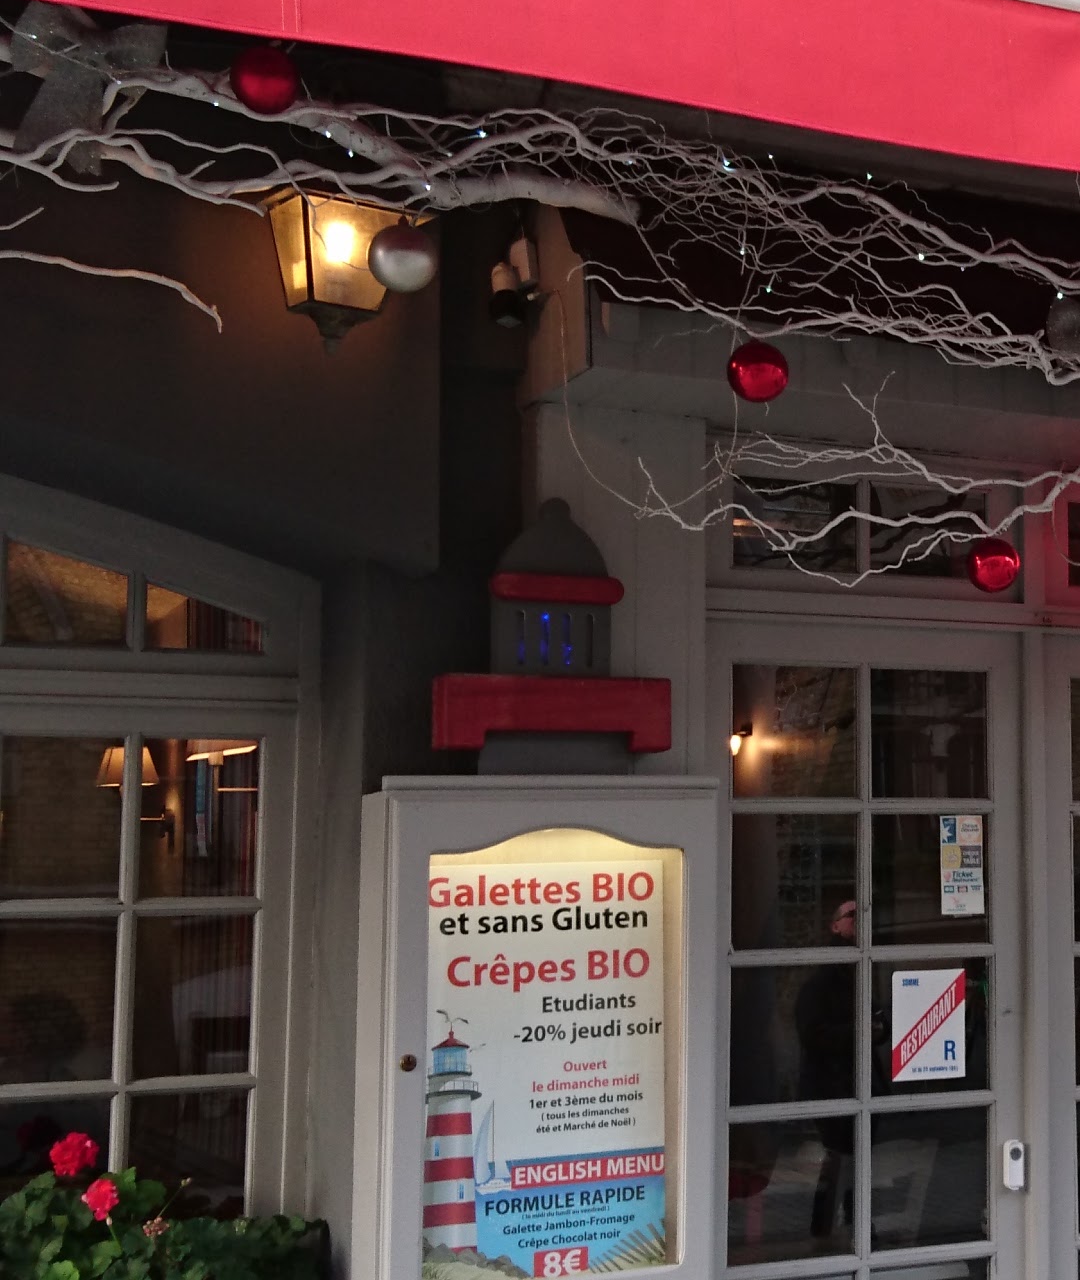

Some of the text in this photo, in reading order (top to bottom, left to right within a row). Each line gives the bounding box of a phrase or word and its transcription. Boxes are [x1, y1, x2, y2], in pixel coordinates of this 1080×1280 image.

[428, 871, 655, 908] Galettes BIO
[439, 906, 648, 936] et sans Gluten
[447, 947, 650, 993] Crêpes BIO
[542, 993, 636, 1014] Etudiants
[513, 1017, 663, 1045] -20% jeudi soir
[900, 982, 957, 1067] RESTAURANT
[944, 1039, 956, 1061] R
[563, 1060, 607, 1073] Ouvert
[532, 1073, 640, 1093] le dimanche midi
[530, 1090, 643, 1110] 1er et 3ème du mois
[546, 1111, 566, 1121] tous
[568, 1109, 580, 1119] les
[582, 1106, 629, 1118] dimanches
[536, 1123, 550, 1134] été
[552, 1123, 562, 1132] et
[563, 1120, 596, 1132] Marché
[598, 1119, 609, 1128] de
[611, 1117, 631, 1127] Noël
[514, 1153, 664, 1186] ENGLISH MENU
[484, 1185, 645, 1217] FORMULE RAPIDE
[502, 1213, 636, 1236] Galette Jambon-Fromage
[517, 1228, 621, 1250] Crêpe Chocolat noir
[542, 1248, 582, 1278] 8€
